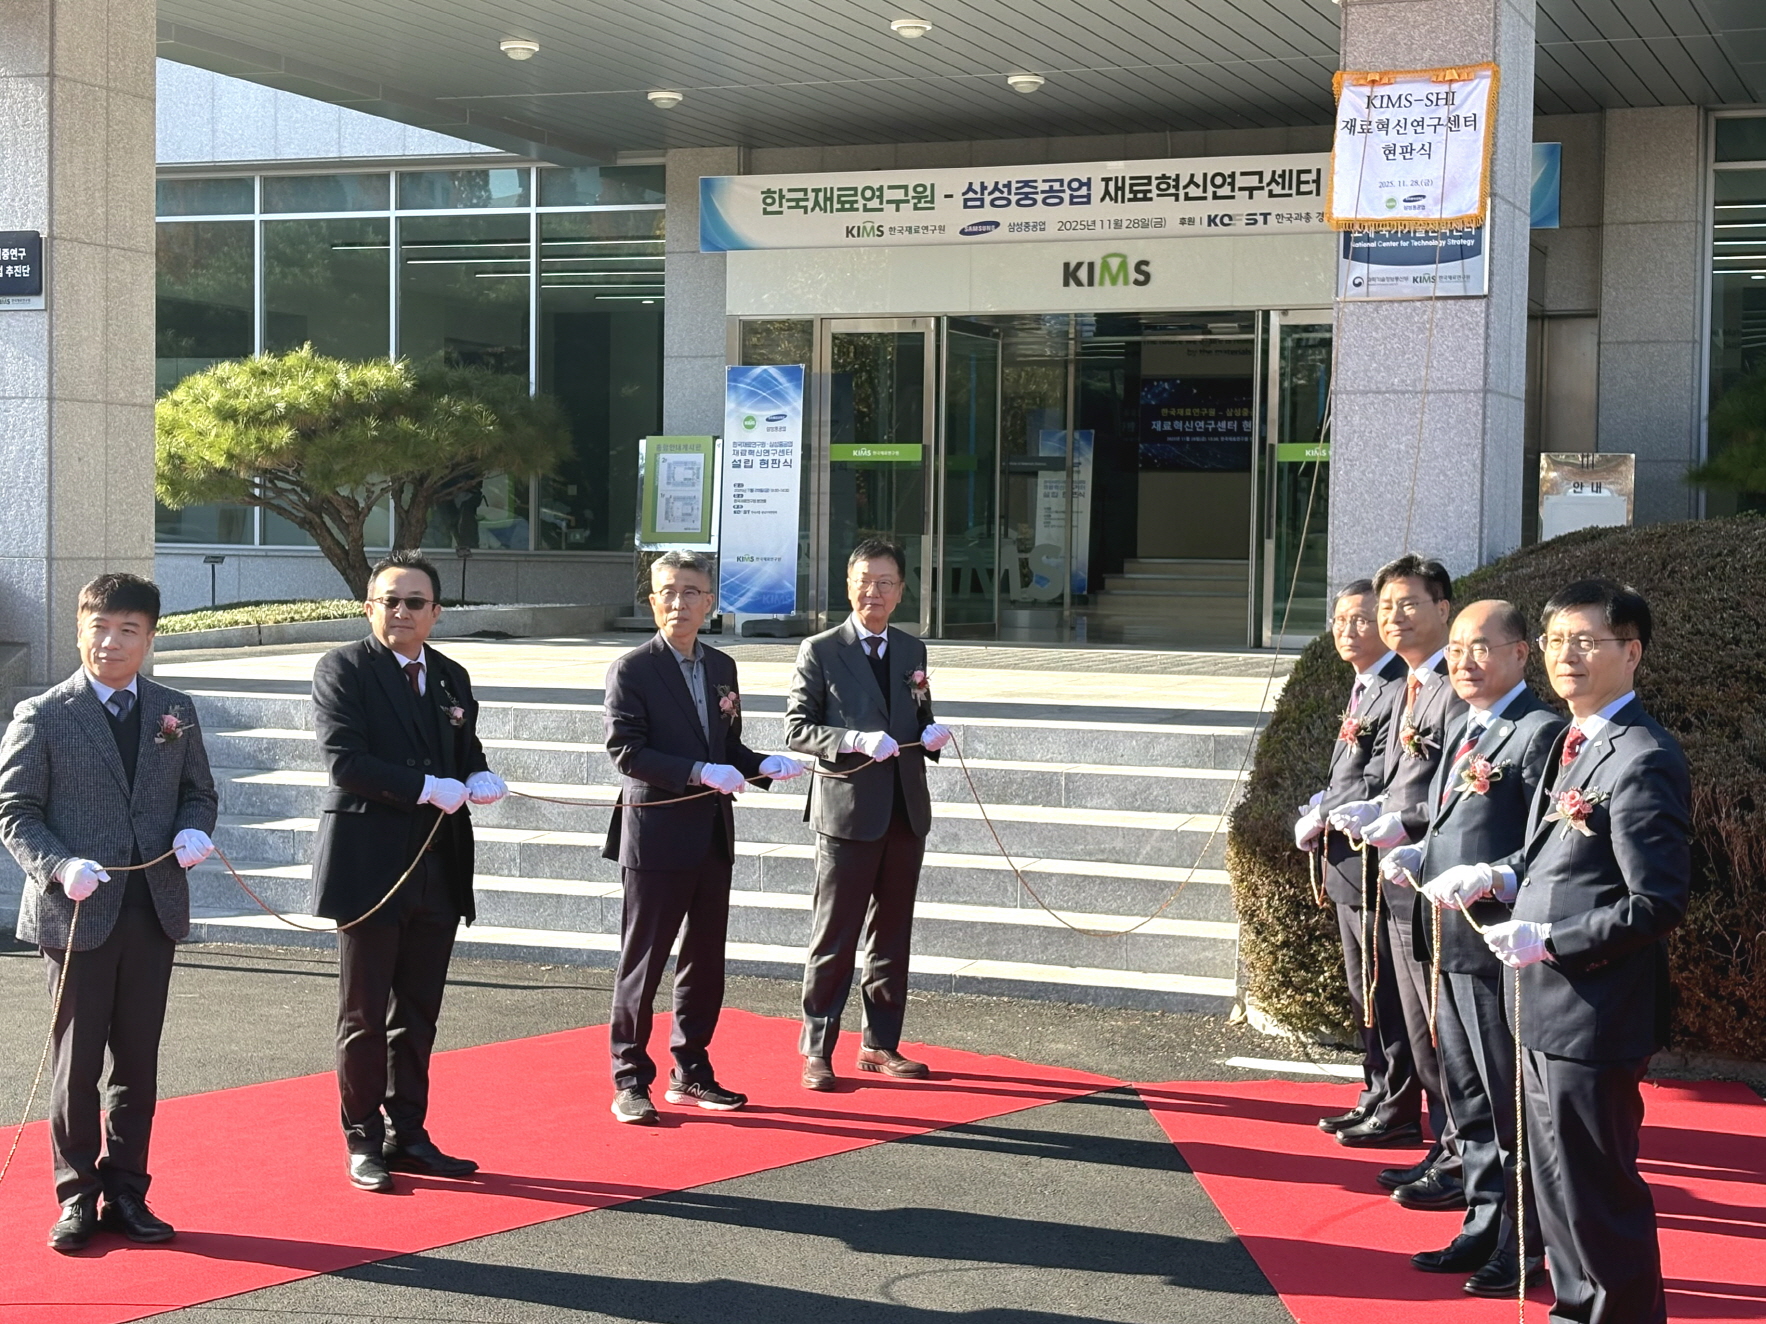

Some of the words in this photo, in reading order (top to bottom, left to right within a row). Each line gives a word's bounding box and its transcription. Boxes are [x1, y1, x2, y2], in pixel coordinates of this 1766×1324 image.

[1366, 91, 1456, 110] KIMS-SHI
[1340, 112, 1478, 136] 재료혁신연구센터
[1381, 141, 1433, 162] 현판식
[760, 182, 936, 216] 한국재료연구원
[961, 176, 1093, 210] 삼성중공업
[1099, 167, 1322, 205] 재료혁신연구센터
[1057, 218, 1097, 232] 2025년
[1099, 218, 1123, 230] 11월
[1125, 216, 1167, 230] 28일(금)
[1178, 216, 1196, 227] 후원
[1275, 213, 1312, 225] 한국과총
[846, 220, 885, 238] KIMS
[888, 224, 946, 236] 한국재료연구원
[1007, 221, 1046, 233] 삼성중공업
[1447, 238, 1475, 247] Strategy
[6, 264, 31, 278] 추진단
[1062, 252, 1152, 288] KIMS
[1412, 272, 1437, 284] KIMS
[1151, 420, 1238, 432] 재료혁신연구센터
[852, 448, 871, 457] KIMS
[1305, 447, 1327, 457] KIMS
[731, 458, 754, 469] 설립
[759, 458, 793, 469] 현판식
[736, 554, 755, 562] KIMS
